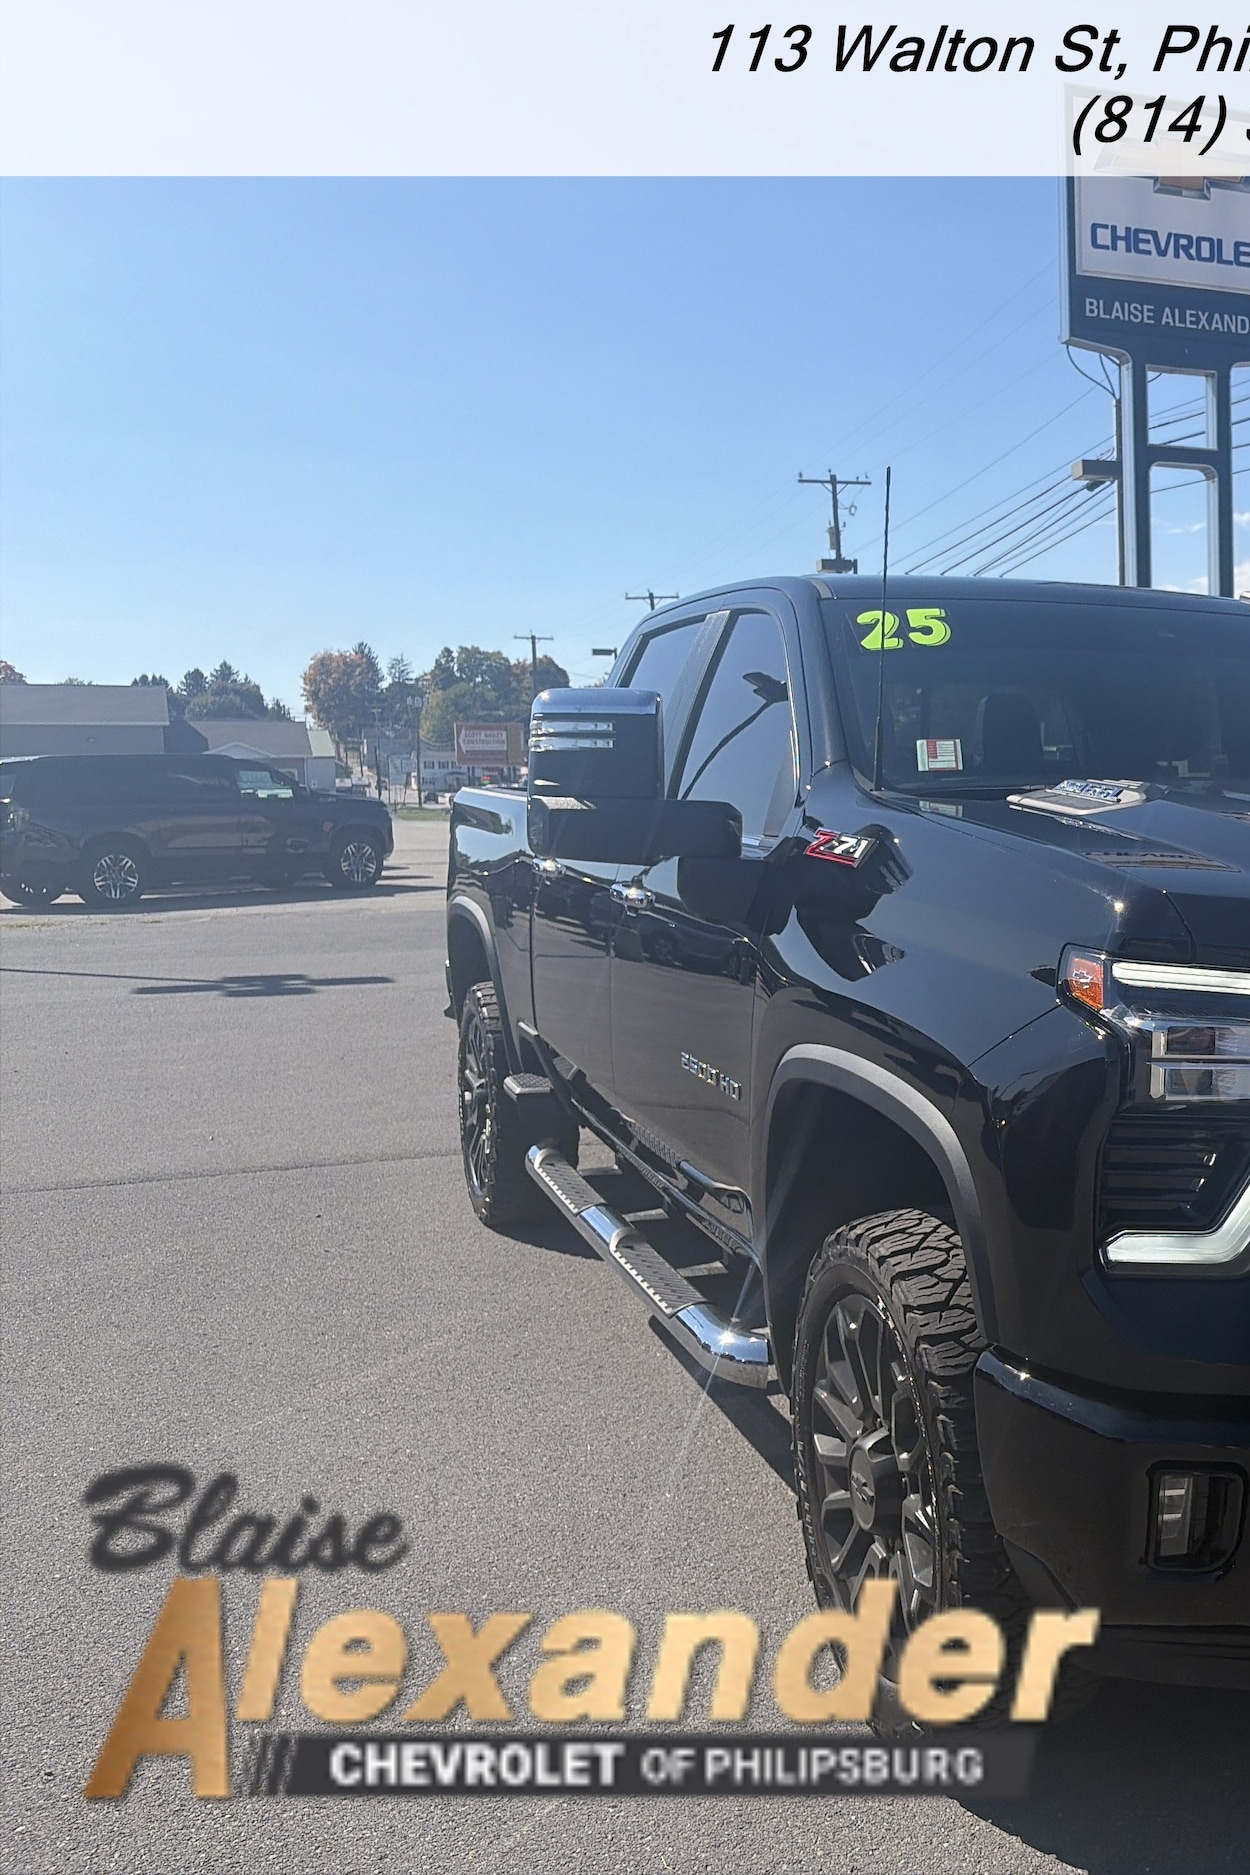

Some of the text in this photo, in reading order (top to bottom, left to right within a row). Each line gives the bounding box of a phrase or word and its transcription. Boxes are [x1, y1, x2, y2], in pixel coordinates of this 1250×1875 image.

[1085, 298, 1155, 324] BLAISE
[856, 607, 952, 651] 25
[803, 827, 876, 869] Z71
